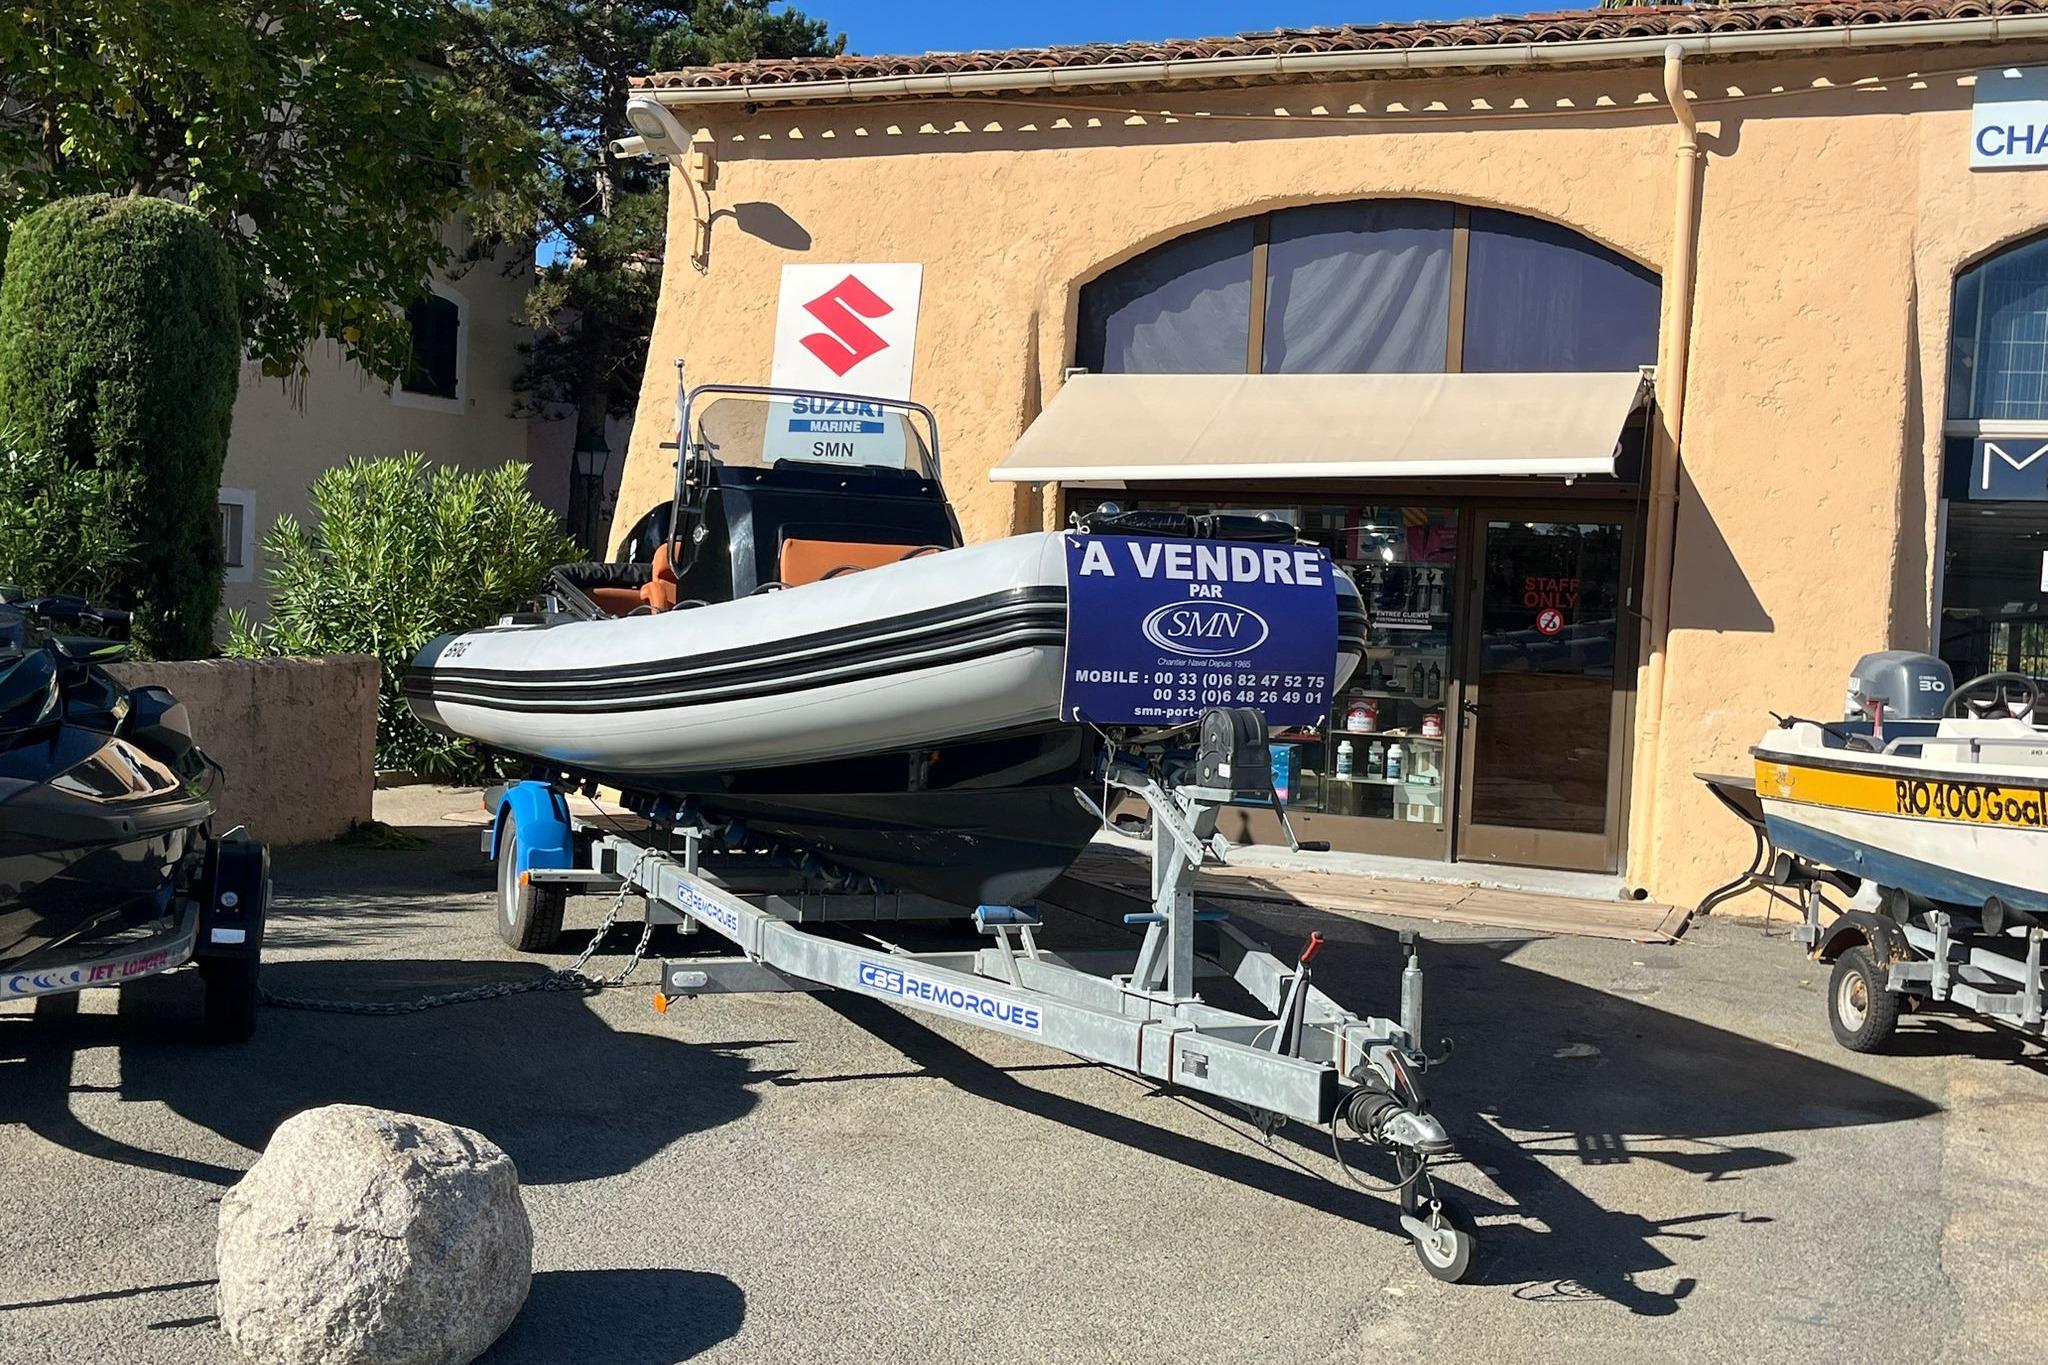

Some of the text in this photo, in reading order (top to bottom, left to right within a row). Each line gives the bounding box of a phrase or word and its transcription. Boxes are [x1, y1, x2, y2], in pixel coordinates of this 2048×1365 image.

[793, 396, 884, 417] SUZUKI
[810, 421, 861, 432] MARINE
[812, 441, 854, 457] SMN
[1079, 540, 1323, 586] A VENDRE
[1189, 583, 1223, 598] PAR
[1524, 577, 1579, 592] STAFF
[1524, 592, 1578, 608] ONLY
[1167, 610, 1244, 638] SMN
[1157, 657, 1187, 667] Chantier
[1187, 658, 1208, 667] Naval
[1208, 658, 1232, 668] Depuis
[1075, 669, 1139, 684] MOBILE
[1154, 672, 1174, 685] 00
[1178, 673, 1198, 686] 33
[1202, 673, 1233, 689] (0)6
[1237, 674, 1256, 687] 82
[1260, 675, 1280, 688] 47
[1284, 675, 1302, 688] 52
[1307, 676, 1325, 689] 75
[1919, 680, 1945, 692] 30
[1153, 688, 1322, 705] 00 33 (0)6 48 26 49 01
[1895, 779, 1931, 815] RIO
[1934, 781, 1982, 819] 400
[87, 963, 117, 982] JET
[906, 979, 1040, 1029] REMORQUES
